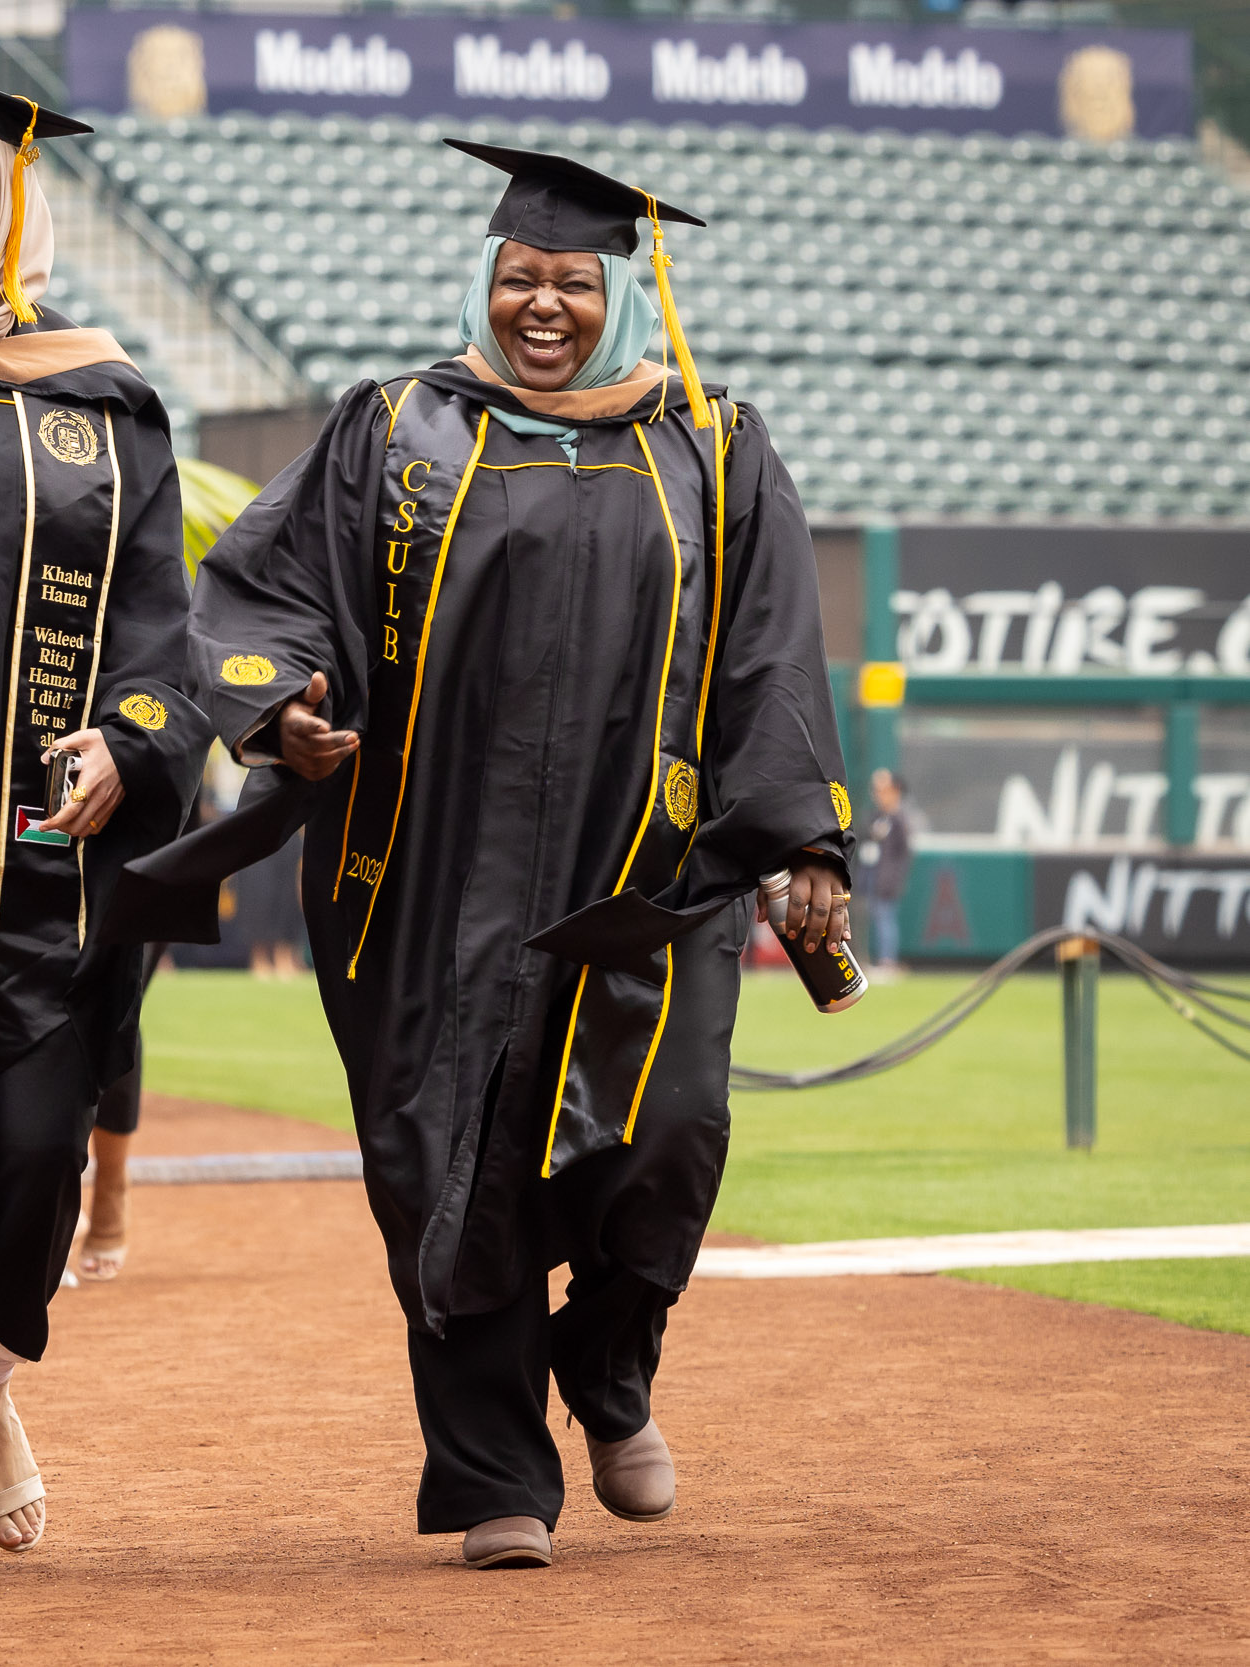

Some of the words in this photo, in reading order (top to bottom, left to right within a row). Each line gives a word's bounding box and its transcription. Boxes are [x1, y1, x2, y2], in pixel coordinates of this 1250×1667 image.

[255, 30, 411, 96] Modelo
[454, 33, 610, 100] Modelo
[652, 39, 807, 105] Modelo
[849, 43, 1003, 110] Modelo
[41, 564, 93, 589] Khaled
[40, 584, 88, 608] Hanaa
[34, 626, 85, 650] Waleed
[39, 648, 77, 672] Ritaj
[28, 667, 78, 690] Hamza
[29, 688, 37, 704] I
[38, 690, 61, 708] did
[62, 693, 74, 710] it
[31, 708, 50, 726] for
[52, 716, 66, 729] us
[995, 742, 1250, 850] NITT
[346, 851, 383, 886] 2023
[1062, 852, 1250, 941] NITT
